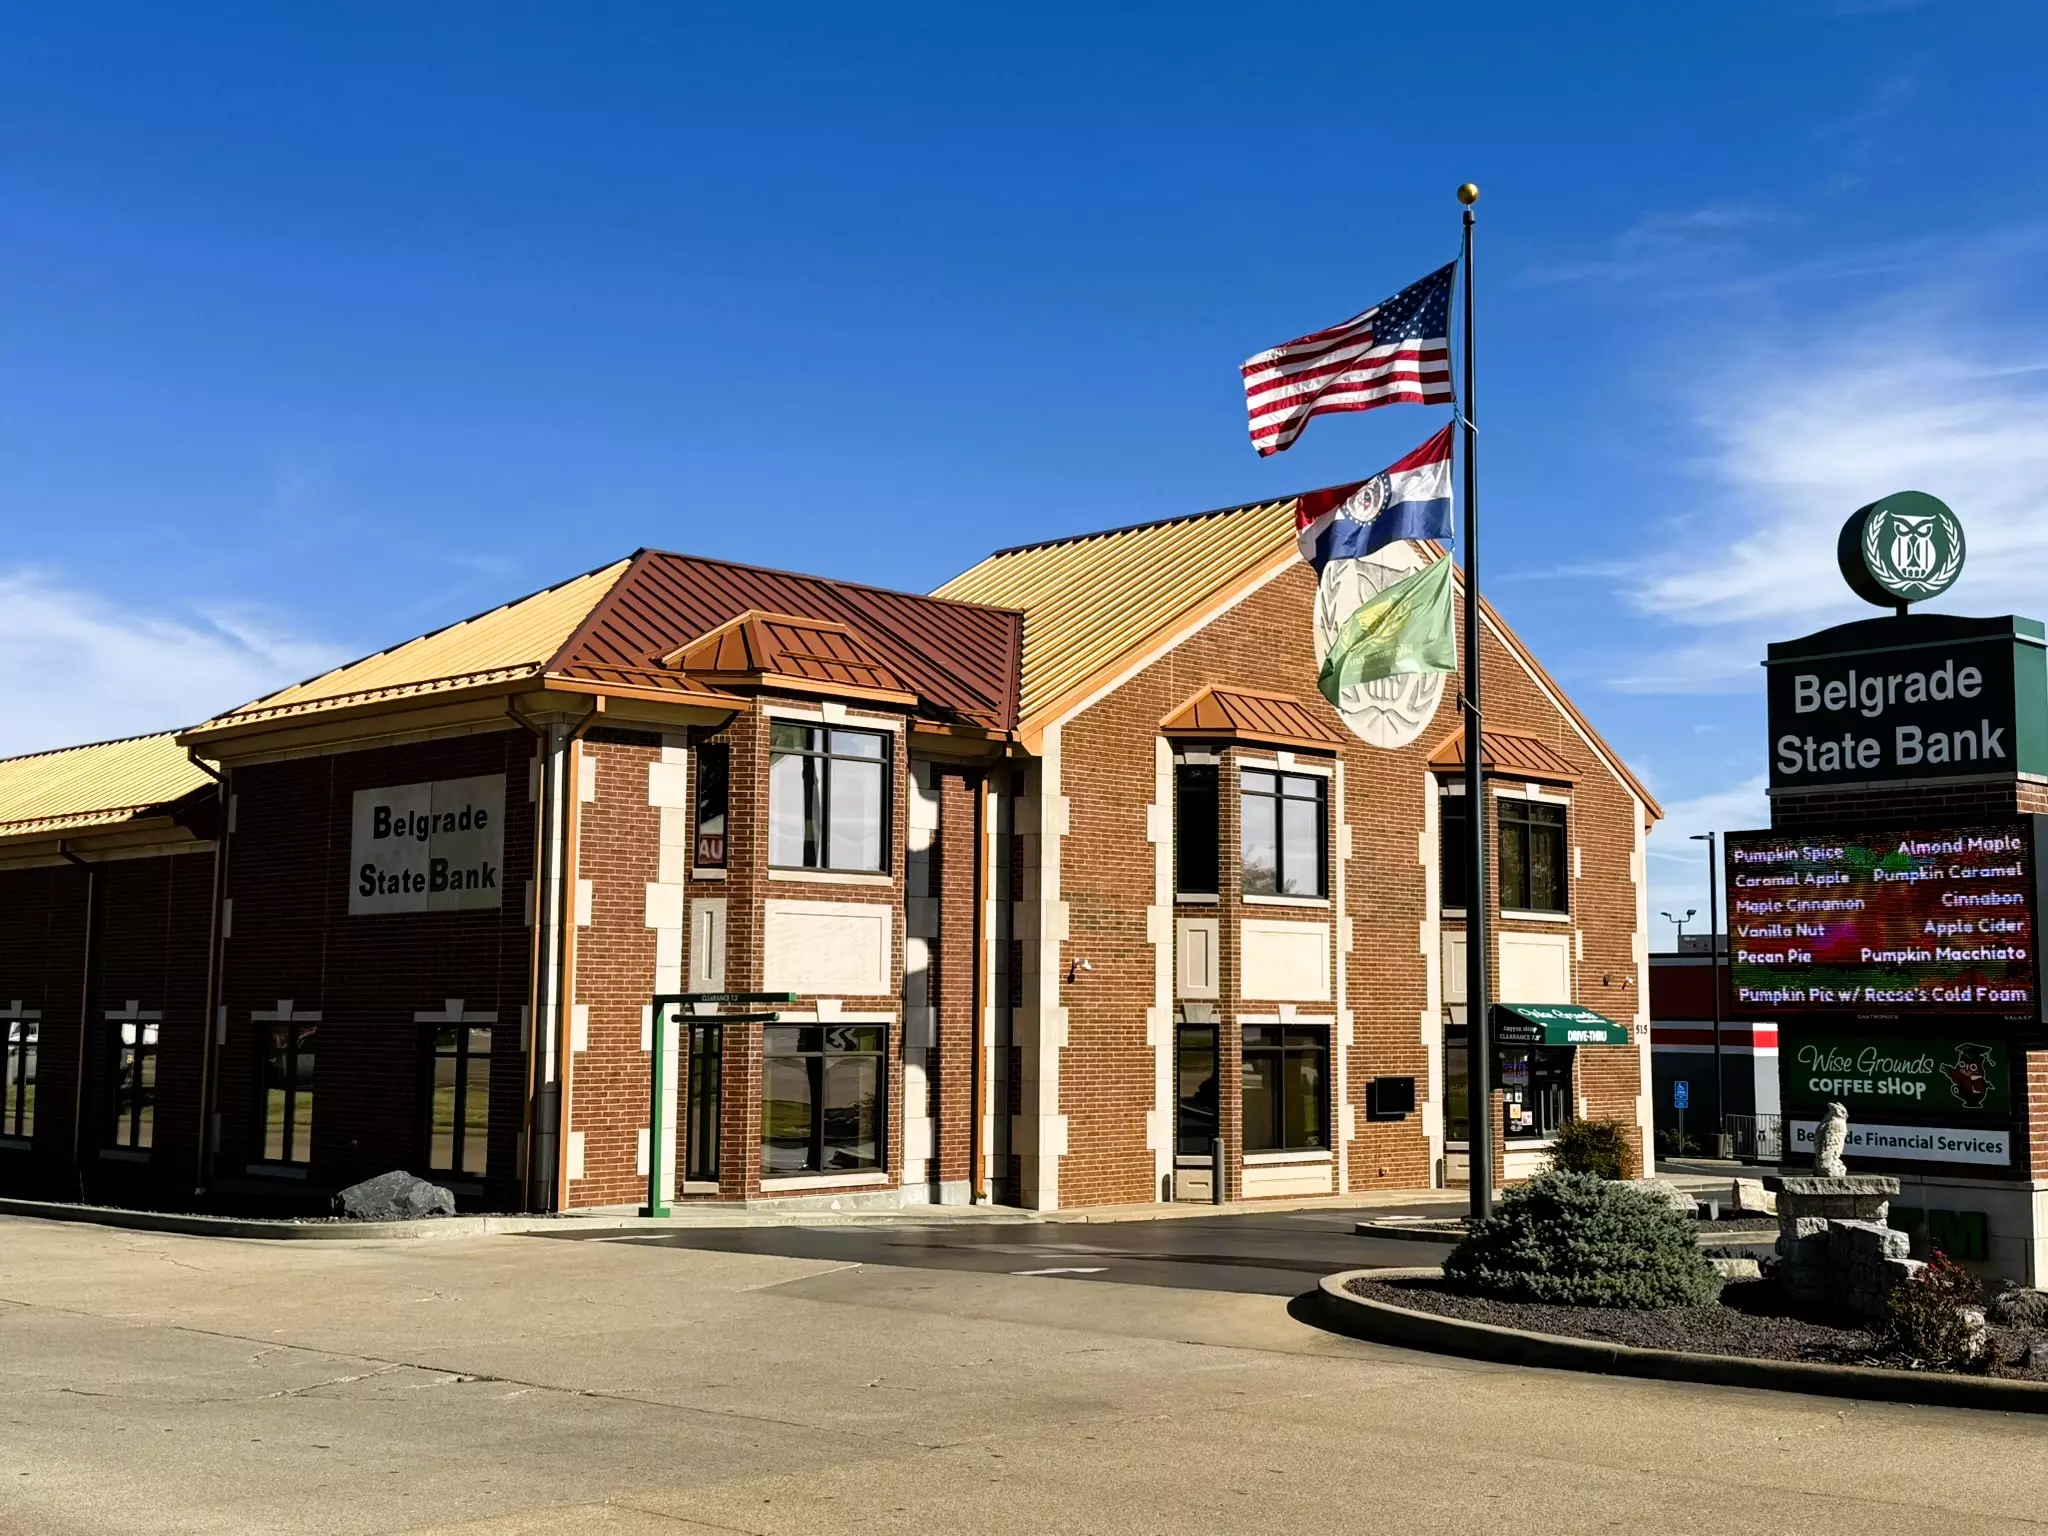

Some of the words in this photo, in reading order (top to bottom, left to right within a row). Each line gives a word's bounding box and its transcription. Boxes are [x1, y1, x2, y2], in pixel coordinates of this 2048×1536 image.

[1794, 659, 1983, 718] Belgrade
[1777, 732, 1881, 774] State
[1895, 719, 2007, 766] Bank
[373, 804, 488, 842] Belgrade
[1734, 846, 1799, 864] Pumpkin
[1802, 845, 1845, 862] Spice
[1898, 837, 1963, 855] Almond
[1967, 835, 2021, 853] Maple
[359, 863, 426, 897] State
[429, 857, 496, 893] Bank
[1735, 872, 1800, 888] Caramel
[1804, 871, 1850, 888] Apple
[1873, 865, 1944, 885] Pumpkin
[1949, 862, 2023, 879] Caramel
[1736, 899, 1783, 915] Maple
[1786, 898, 1865, 912] Cinnamon
[1941, 890, 2025, 907] Cinnabon
[1737, 924, 1793, 938] Vanilla
[1796, 923, 1825, 937] Nut
[1923, 919, 1973, 937] Apple
[1978, 918, 2025, 932] Cider
[1738, 950, 1784, 963] Pecan
[1787, 948, 1812, 963] Pie
[1861, 946, 1931, 965] Pumpkin
[1935, 945, 2027, 961] Macchiato
[1739, 985, 1806, 1006] Pumpkin
[1809, 986, 1834, 1002] Pie
[1838, 986, 1861, 1003] w/
[1864, 987, 1928, 1002] Reese's
[1931, 985, 1972, 1002] Cold
[1976, 987, 2028, 1002] Foam
[1567, 1030, 1608, 1042] DRIVE-THRU
[1635, 1024, 1648, 1035] 515
[1798, 1045, 1852, 1073] Wise
[1857, 1047, 1934, 1076] Grounds
[1808, 1077, 1873, 1097] COFFEE
[1877, 1076, 1927, 1100] SHOP
[1796, 1128, 1862, 1144] Bede
[1865, 1132, 1934, 1150] Financial
[1938, 1136, 2003, 1154] Services
